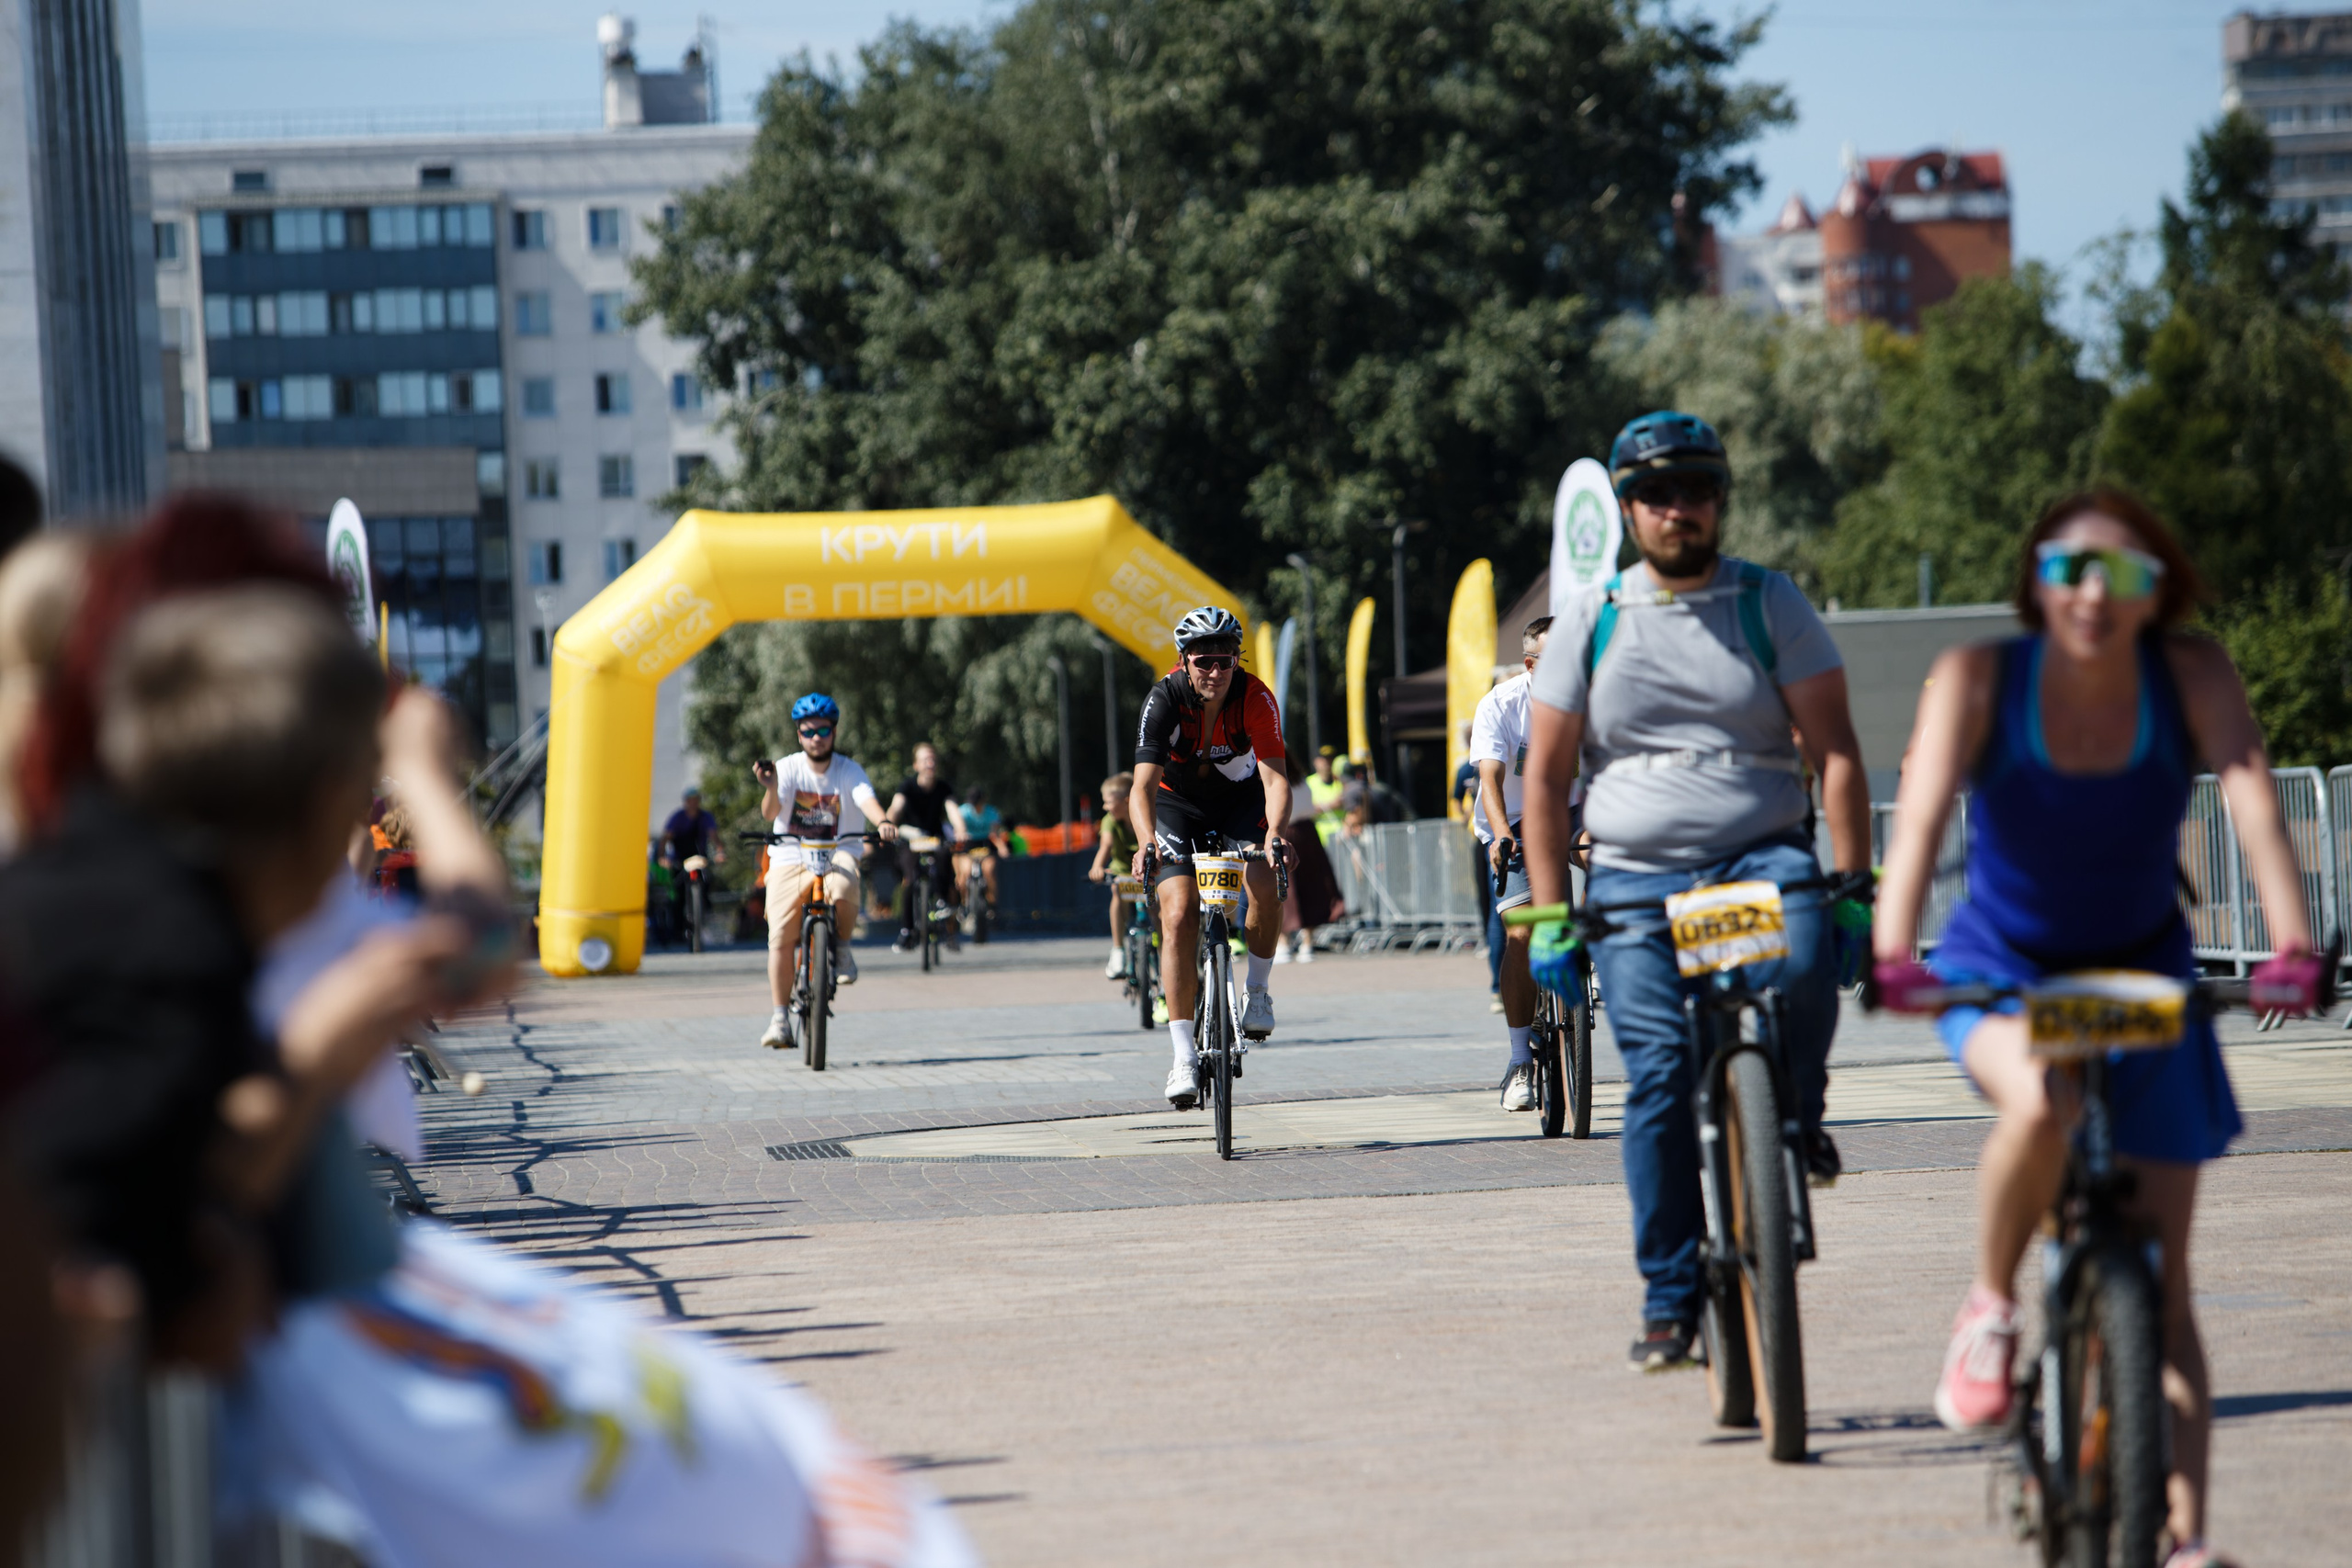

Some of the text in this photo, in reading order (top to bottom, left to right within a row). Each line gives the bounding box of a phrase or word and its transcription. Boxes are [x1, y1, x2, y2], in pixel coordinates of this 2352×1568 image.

[821, 521, 988, 563] КРУТИ
[784, 574, 1028, 614] В ПЕРМИ!
[1199, 872, 1238, 888] 0780
